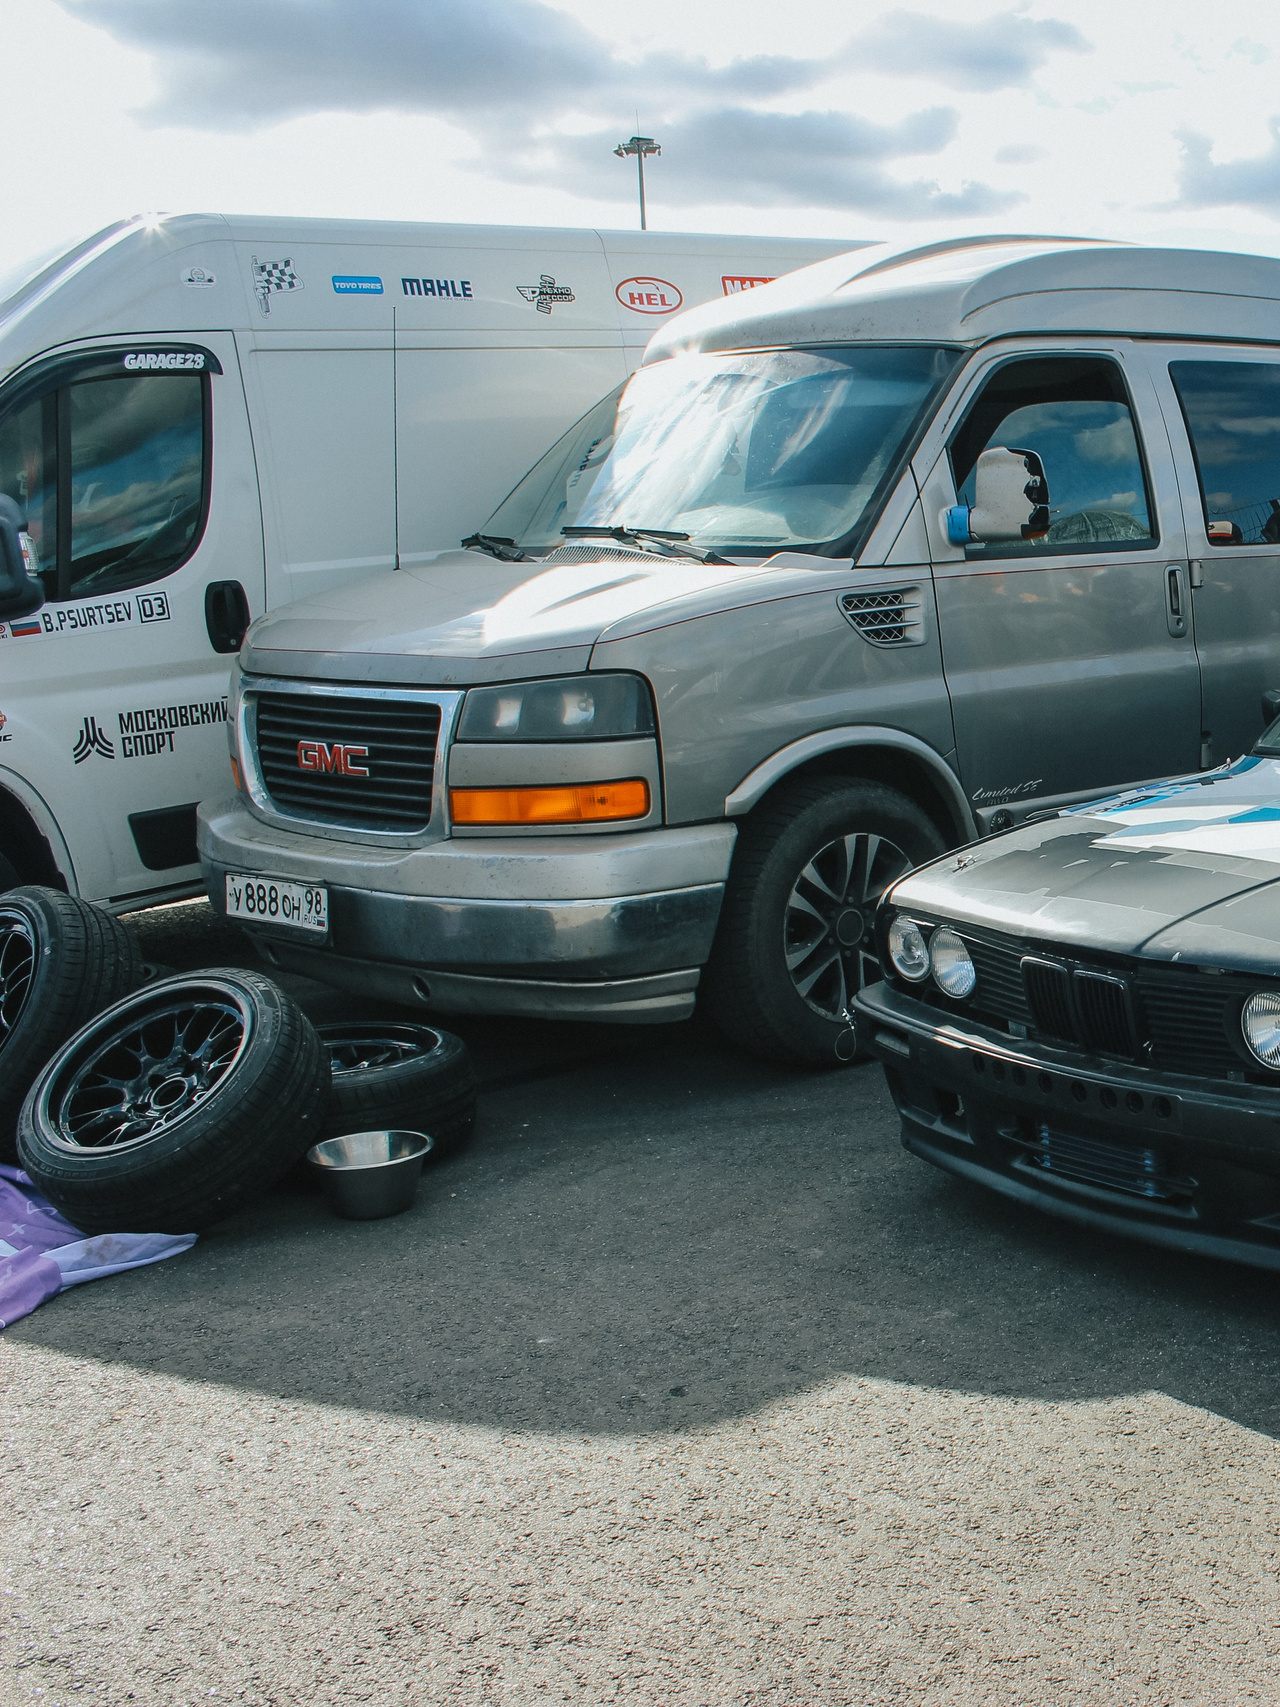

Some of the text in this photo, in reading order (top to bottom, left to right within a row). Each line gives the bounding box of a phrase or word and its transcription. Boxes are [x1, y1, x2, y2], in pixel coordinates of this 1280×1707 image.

[358, 282, 382, 290] TIRES
[401, 278, 473, 297] MAHLE
[628, 292, 673, 306] HEL
[124, 353, 205, 370] GARAGE28
[42, 601, 133, 633] B.PSURTSEV
[142, 596, 166, 619] 03
[122, 730, 175, 758] СПОРТ
[297, 740, 369, 777] GMC
[305, 889, 322, 915] 98
[303, 914, 317, 925] RUS
